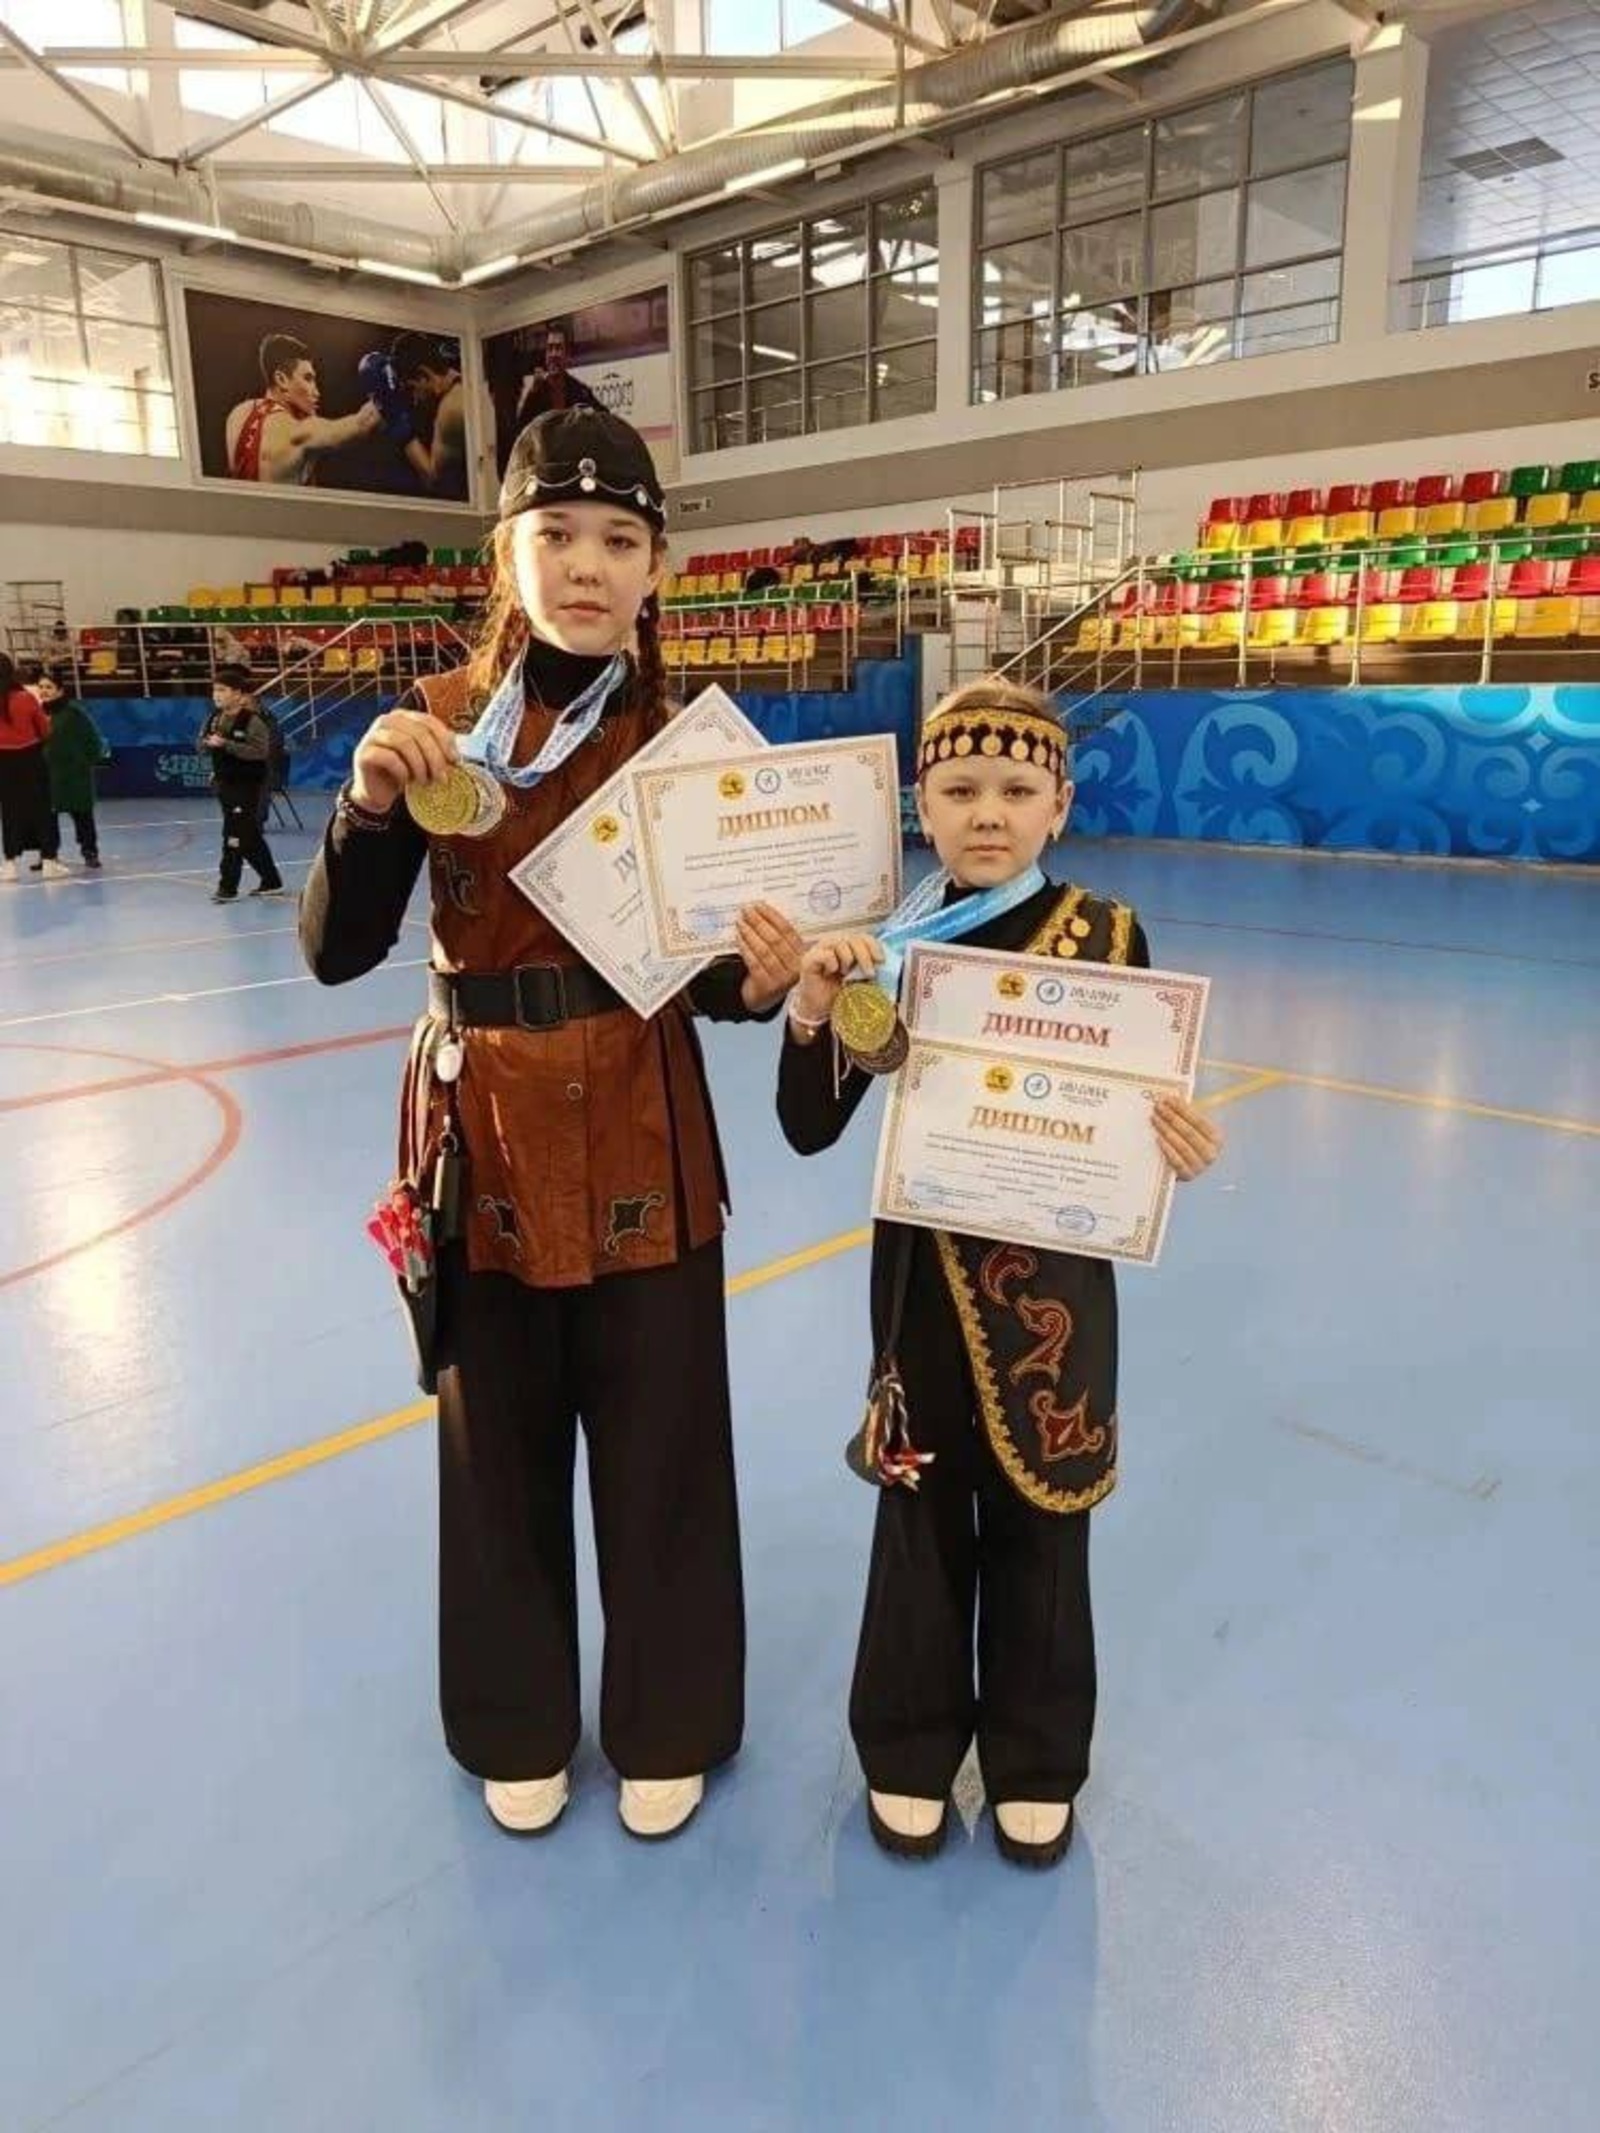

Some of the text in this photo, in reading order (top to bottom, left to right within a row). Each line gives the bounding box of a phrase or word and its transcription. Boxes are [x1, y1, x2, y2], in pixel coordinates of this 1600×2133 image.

[717, 803, 832, 840] ДИПЛОМ
[982, 1012, 1111, 1047] ДИПЛОМ
[968, 1106, 1095, 1145] ДИПЛОМ
